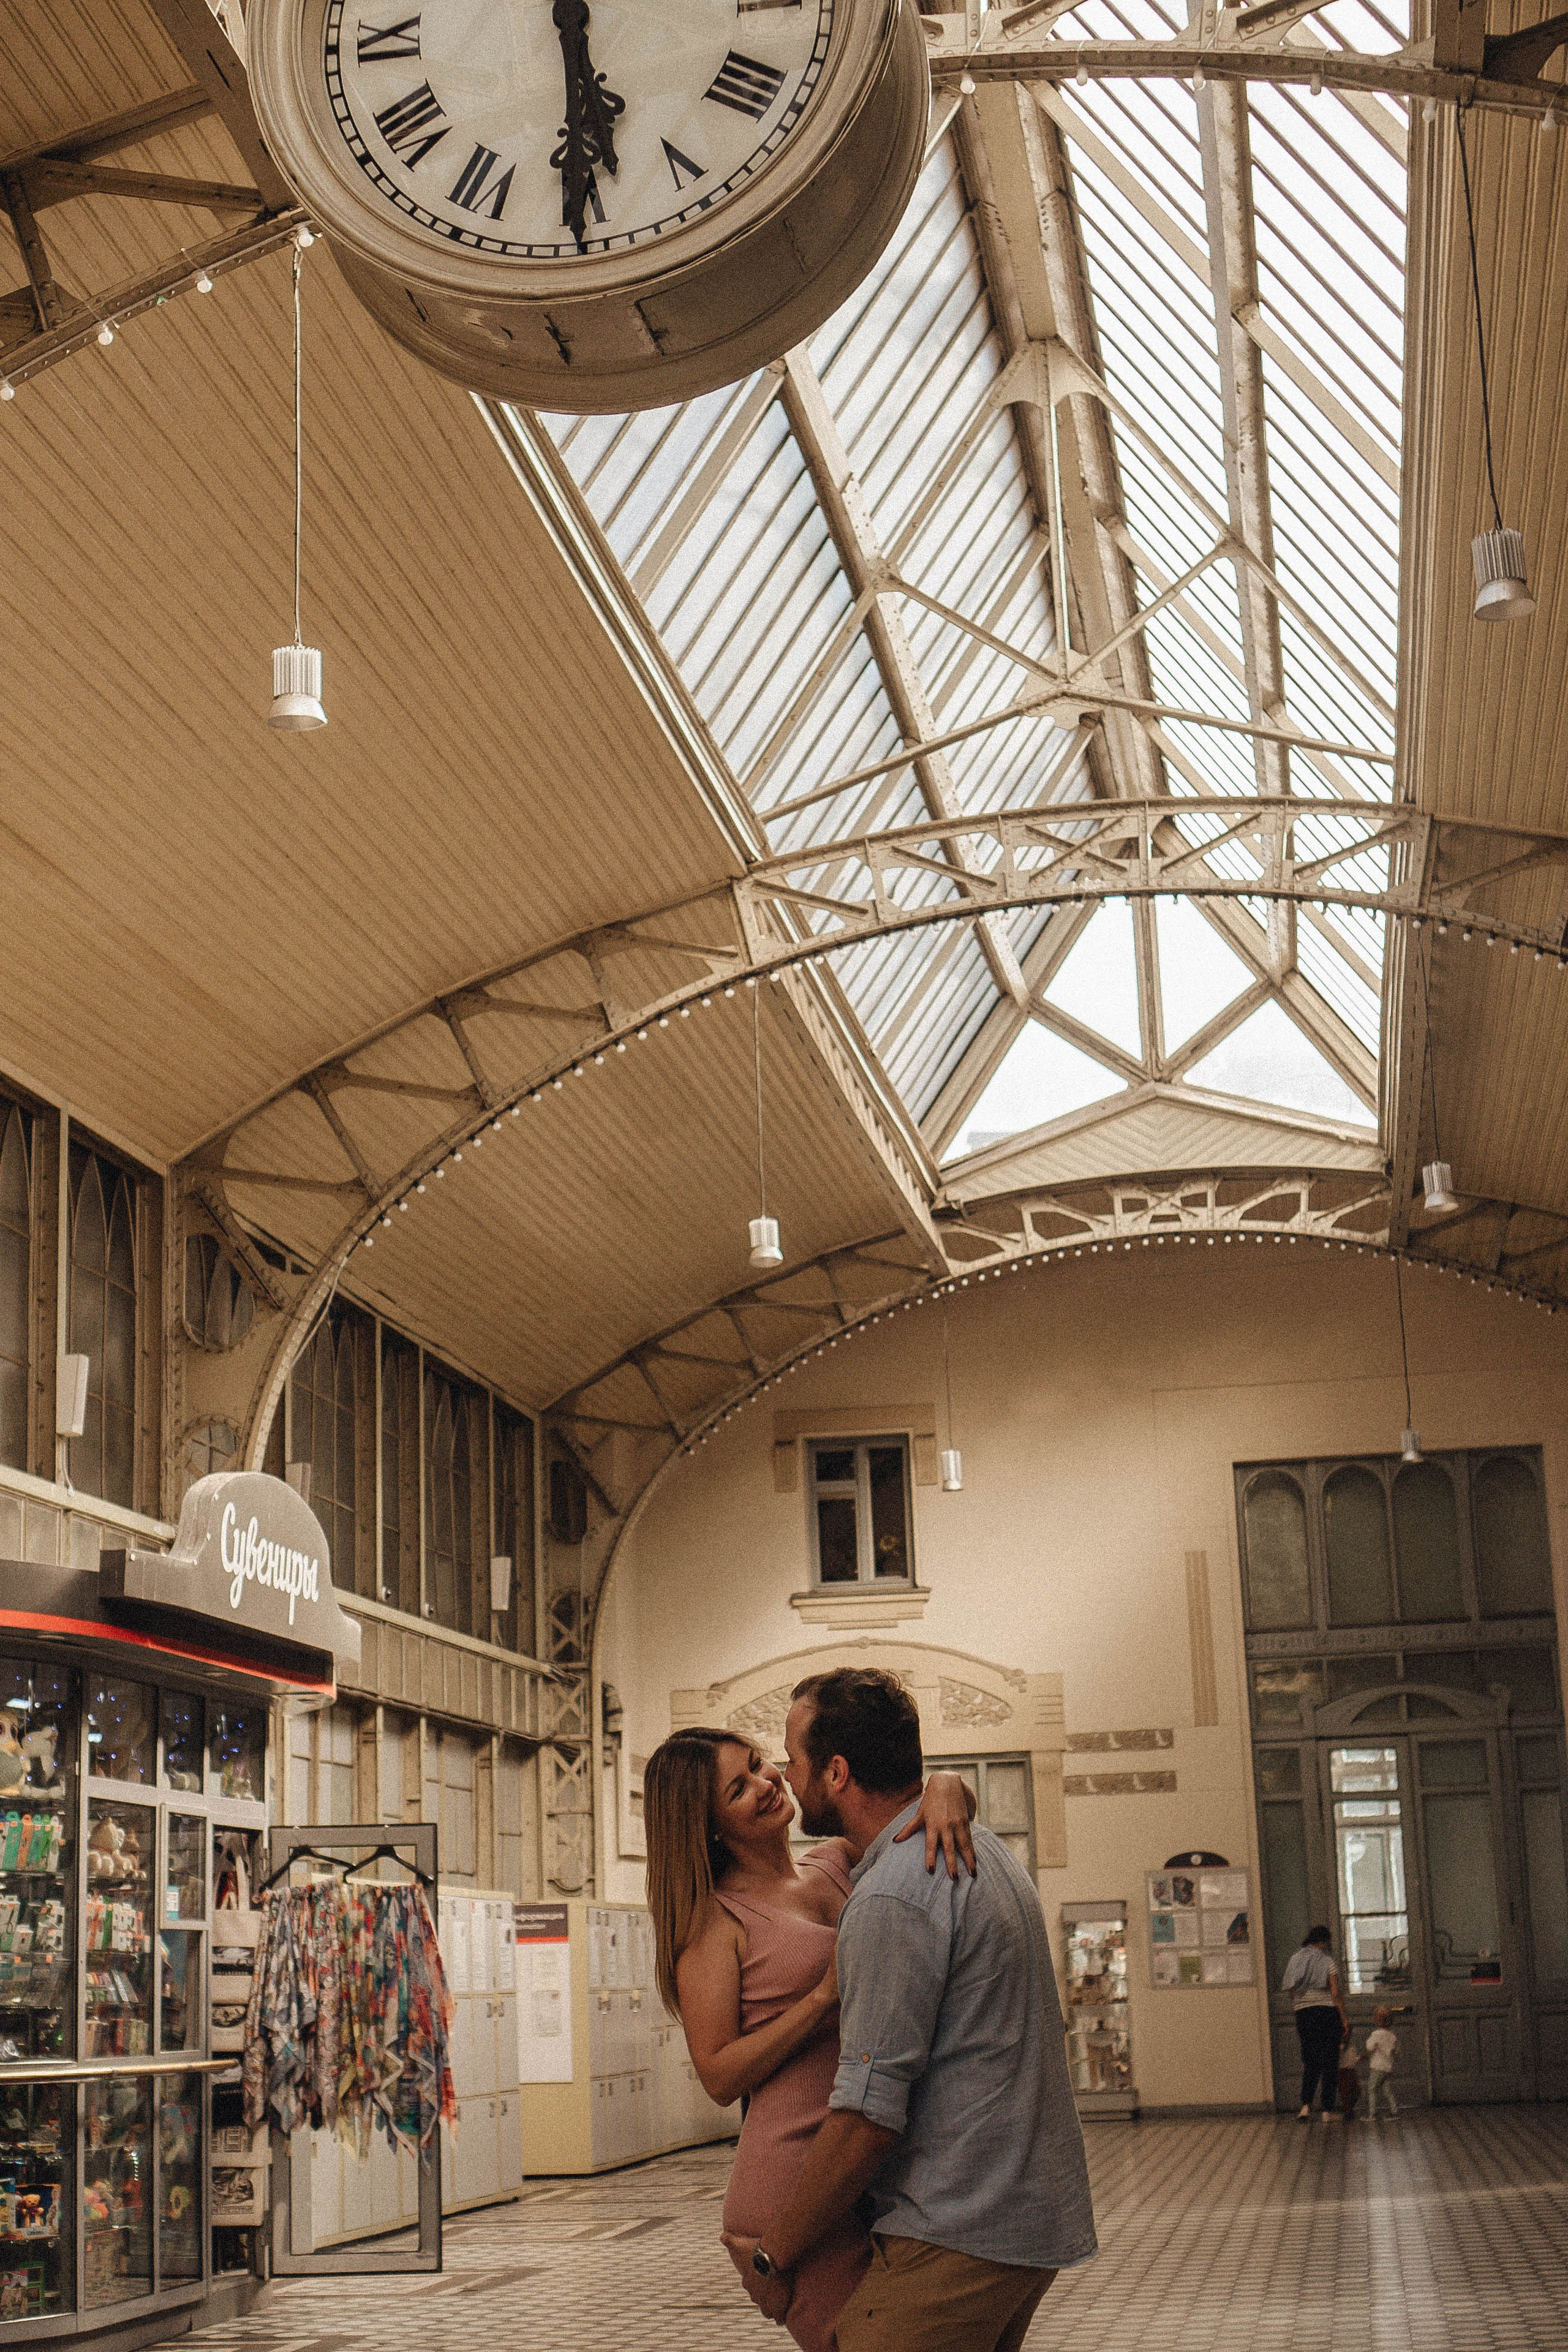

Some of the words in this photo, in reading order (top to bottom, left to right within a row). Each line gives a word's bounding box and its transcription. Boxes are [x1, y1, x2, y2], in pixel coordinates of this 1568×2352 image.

[357, 12, 421, 68] IX
[701, 48, 788, 123] IIII
[373, 78, 453, 172] VIII
[445, 142, 517, 221] VII
[660, 136, 709, 192] V
[221, 1501, 319, 1626] Сувениры
